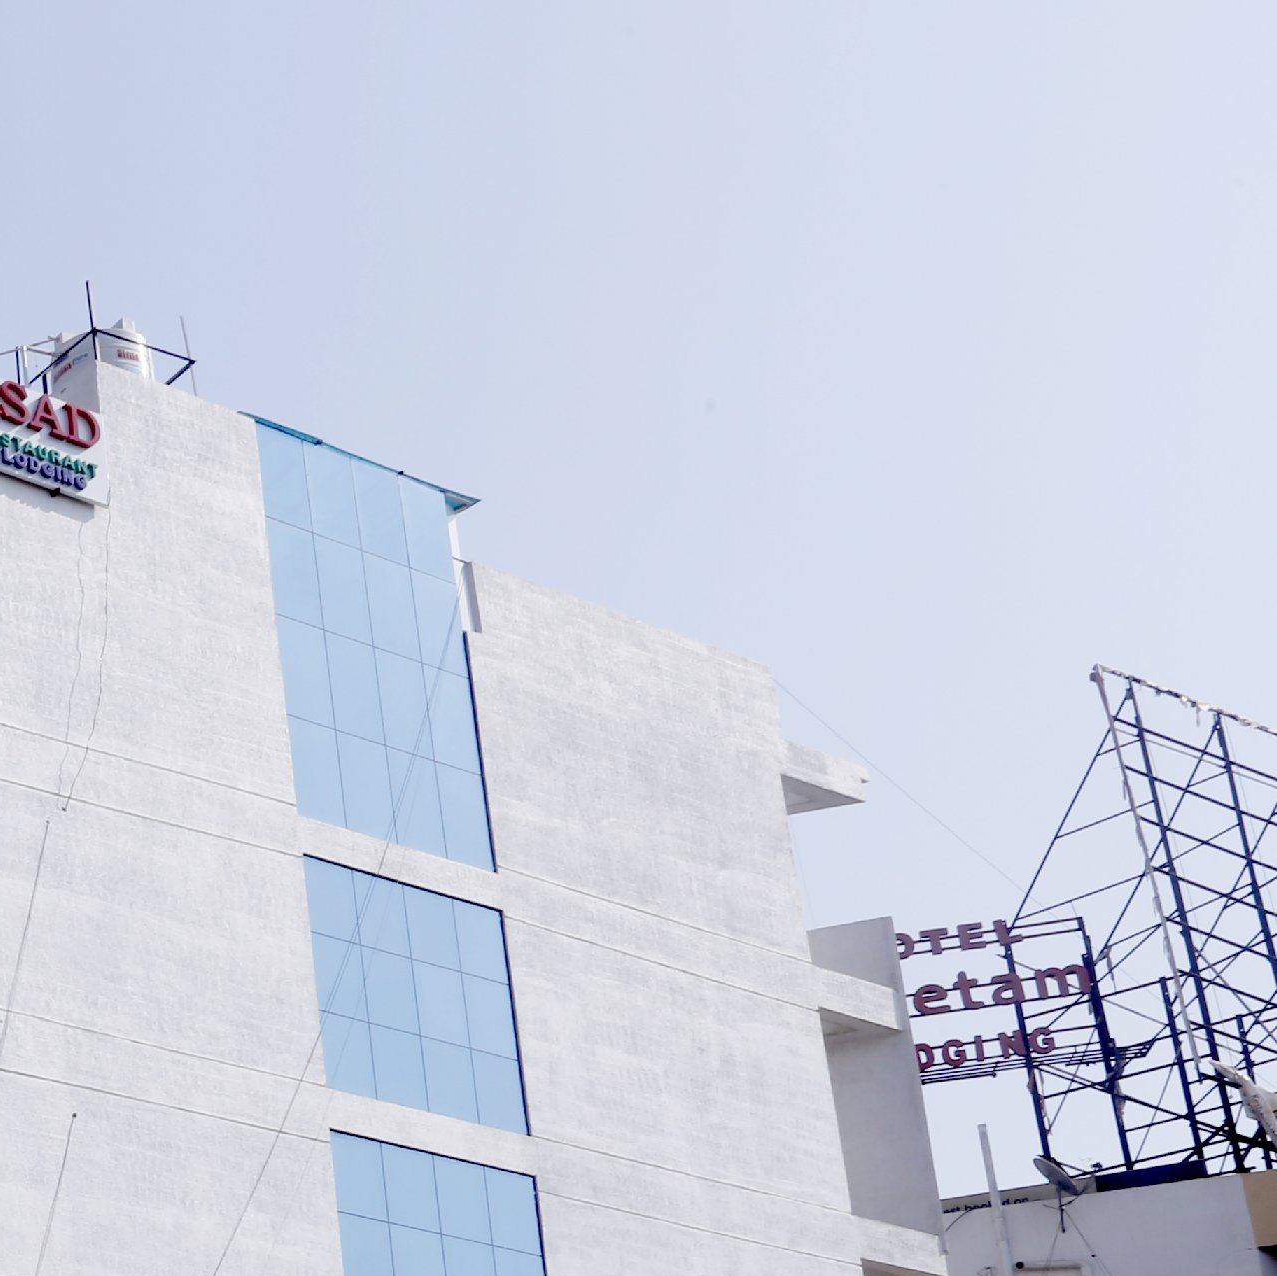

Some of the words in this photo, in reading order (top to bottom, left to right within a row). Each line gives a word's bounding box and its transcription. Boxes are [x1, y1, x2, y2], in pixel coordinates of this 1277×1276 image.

[1, 446, 88, 491] LODGING
[895, 919, 1023, 960] OTEL
[912, 963, 1092, 1016] etam
[915, 1026, 1057, 1071] DGING
